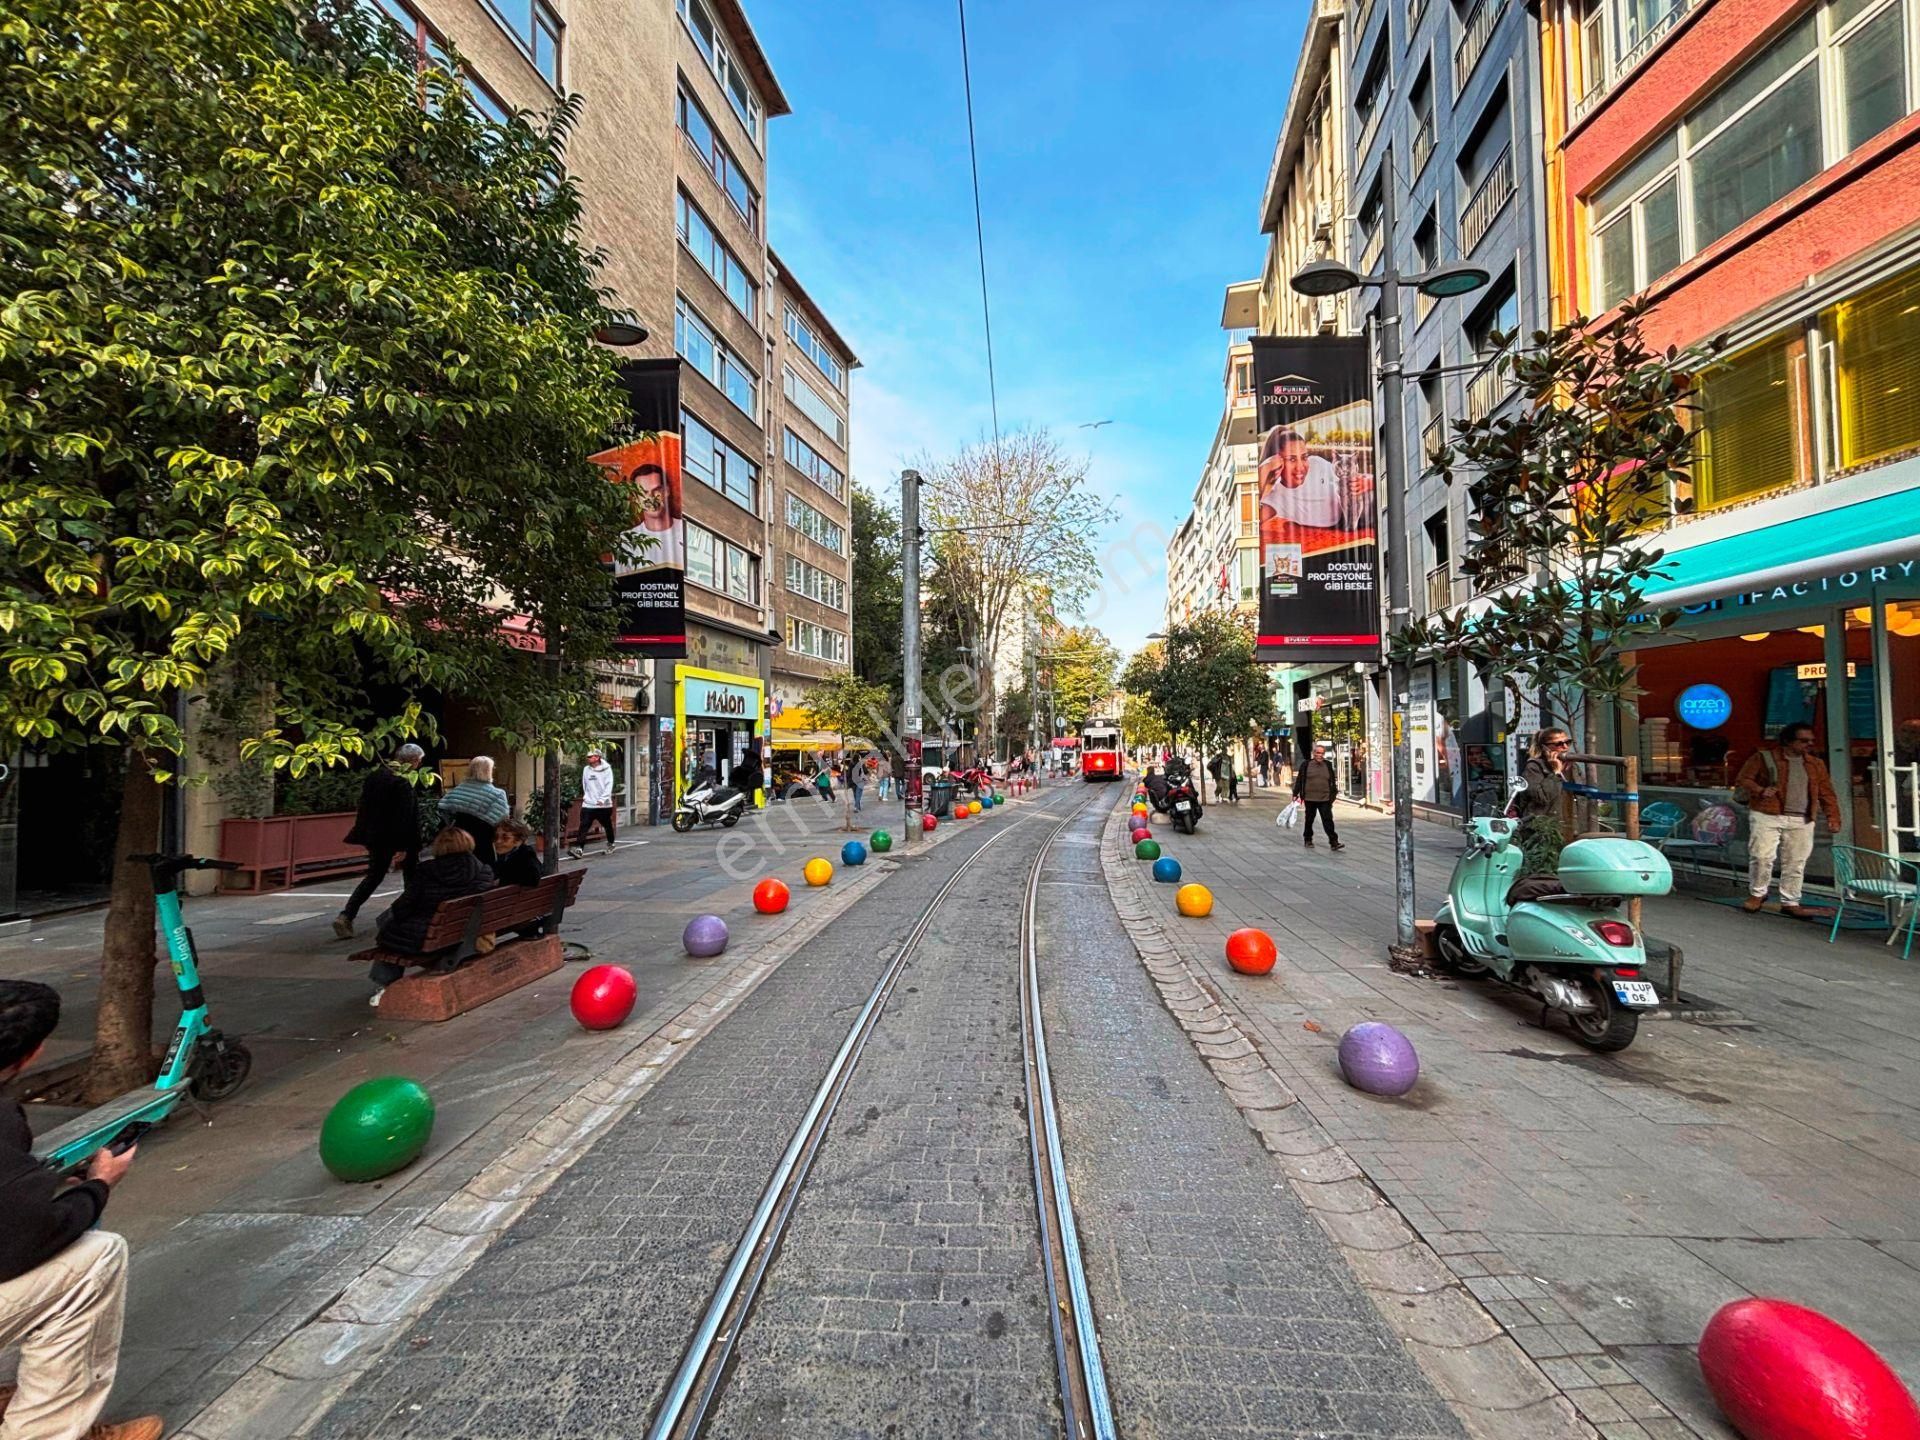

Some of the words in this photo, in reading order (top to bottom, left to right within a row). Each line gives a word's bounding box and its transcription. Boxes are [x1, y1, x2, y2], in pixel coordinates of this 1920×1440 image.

[1263, 395, 1288, 405] PRO
[1290, 395, 1323, 405] PLAN
[1328, 563, 1373, 571] DOSTUNU
[1307, 572, 1373, 581] PROFESYONEL
[640, 583, 679, 591] DOSTUNU
[1324, 581, 1344, 591] GİBİ
[1344, 582, 1373, 591] BESLE
[621, 592, 679, 600] PROFESYONEL
[637, 599, 653, 608] GİBİ
[654, 600, 680, 608] BESLE
[1684, 699, 1725, 709] arzen
[1615, 983, 1629, 991] 34
[1630, 983, 1651, 992] LUP
[1632, 993, 1646, 1002] 06
